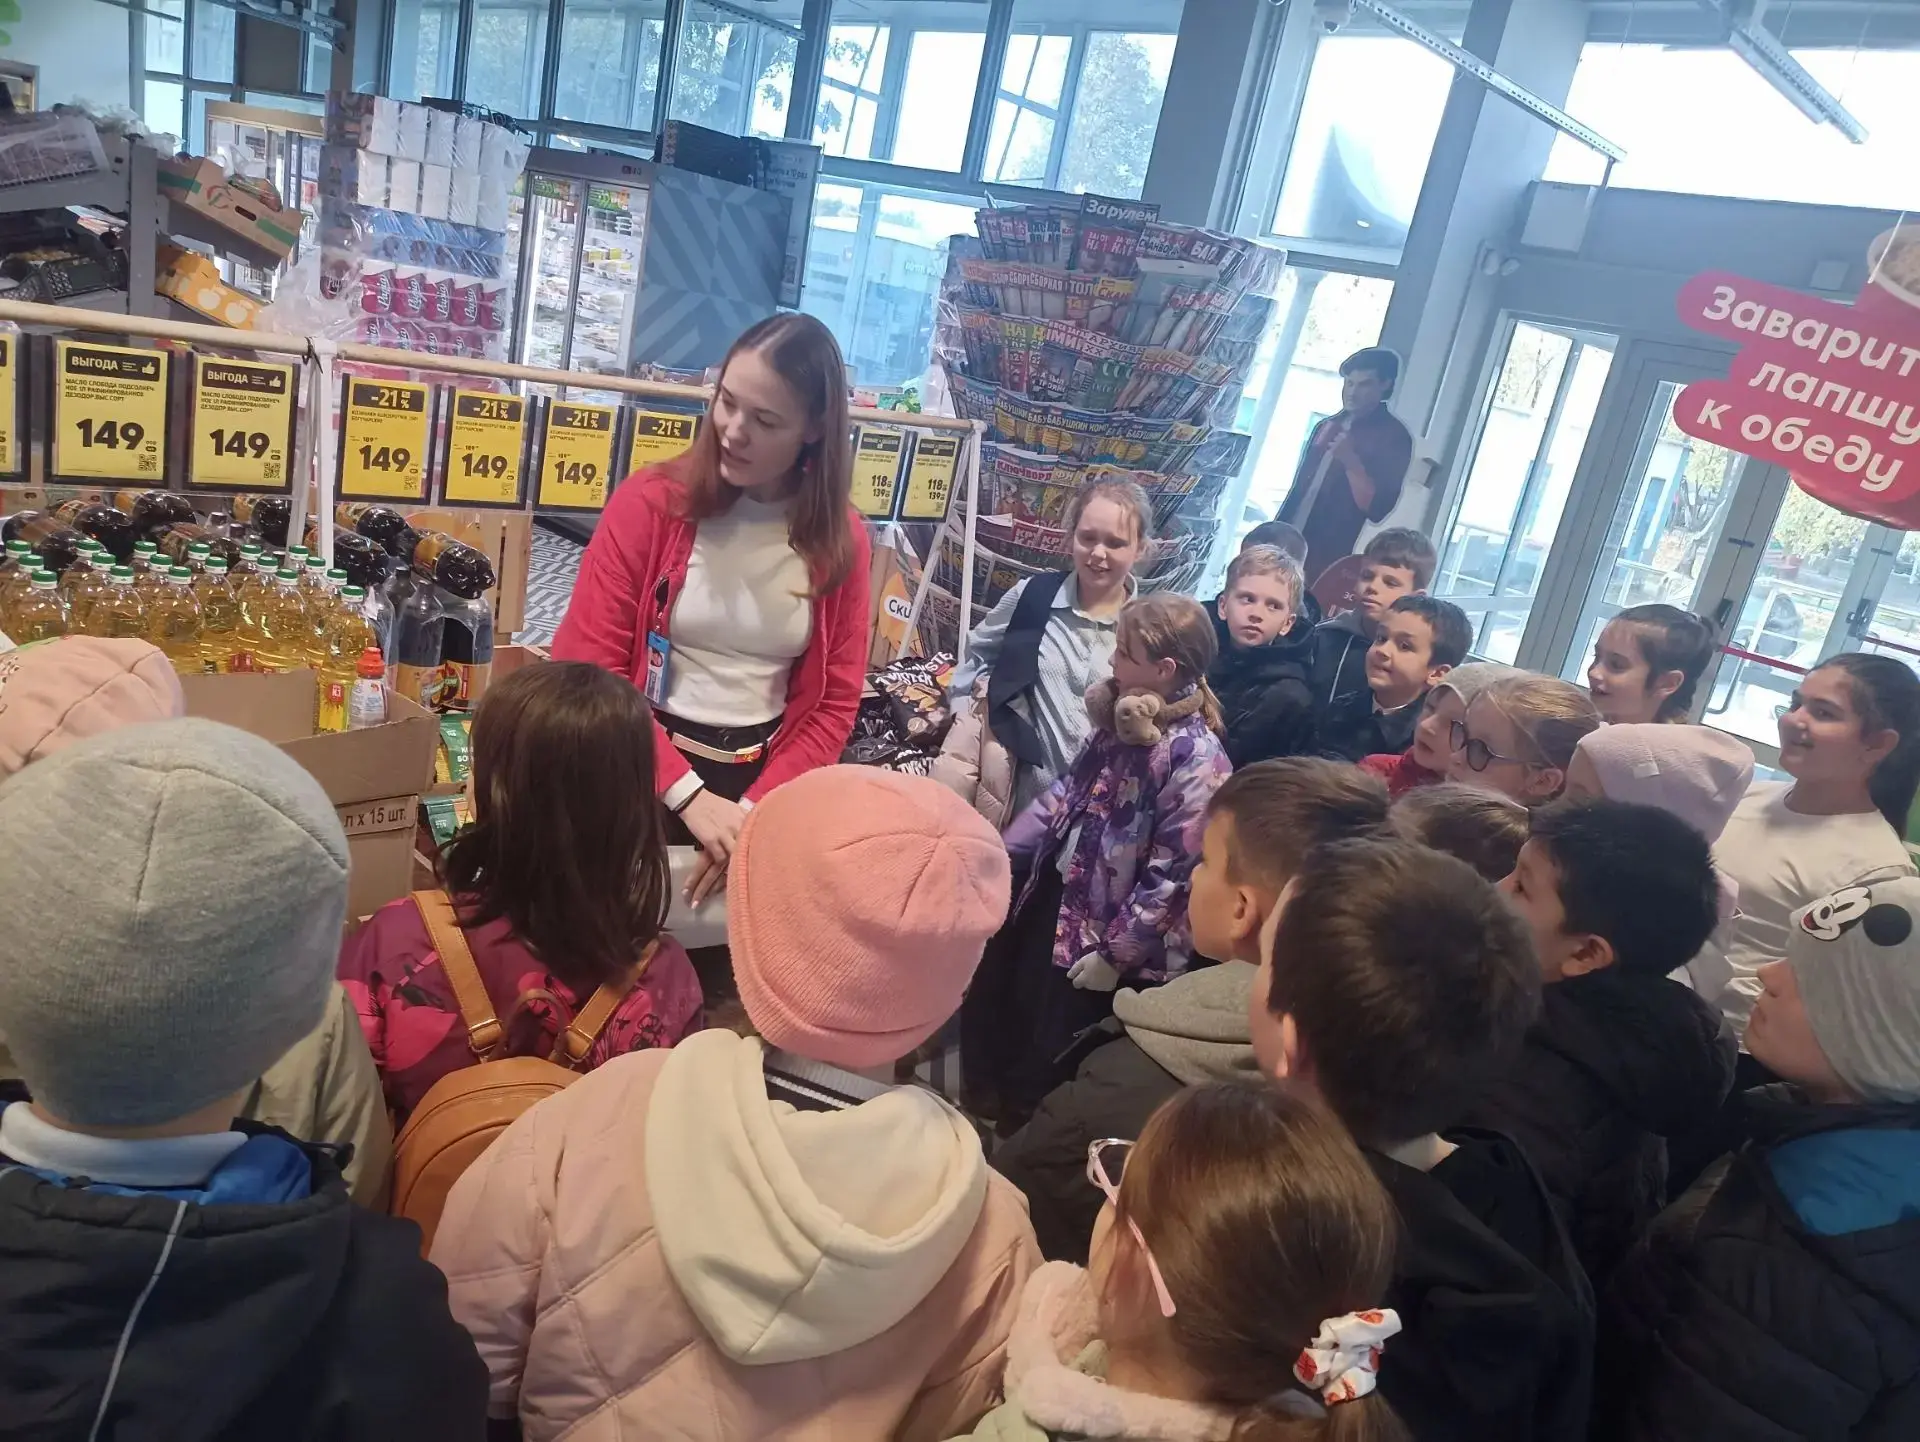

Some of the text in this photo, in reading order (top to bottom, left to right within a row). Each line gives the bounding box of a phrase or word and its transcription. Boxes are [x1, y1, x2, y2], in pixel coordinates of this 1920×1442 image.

[71, 355, 118, 371] ВЫГОДА
[207, 370, 249, 384] ВЫГОДА
[1748, 362, 1920, 445] лапшу
[1047, 413, 1088, 431] БАБУШКИН
[76, 418, 145, 450] 149
[209, 428, 271, 459] 149
[359, 444, 411, 473] 149
[1740, 413, 1904, 492] обеду
[461, 453, 508, 479] 149
[554, 460, 597, 486] 149
[872, 474, 888, 488] 118
[927, 478, 943, 491] 118
[872, 488, 885, 498] 139
[928, 491, 941, 500] 139
[888, 599, 912, 619] Ски
[370, 807, 385, 824] 15
[388, 808, 406, 823] шт.
